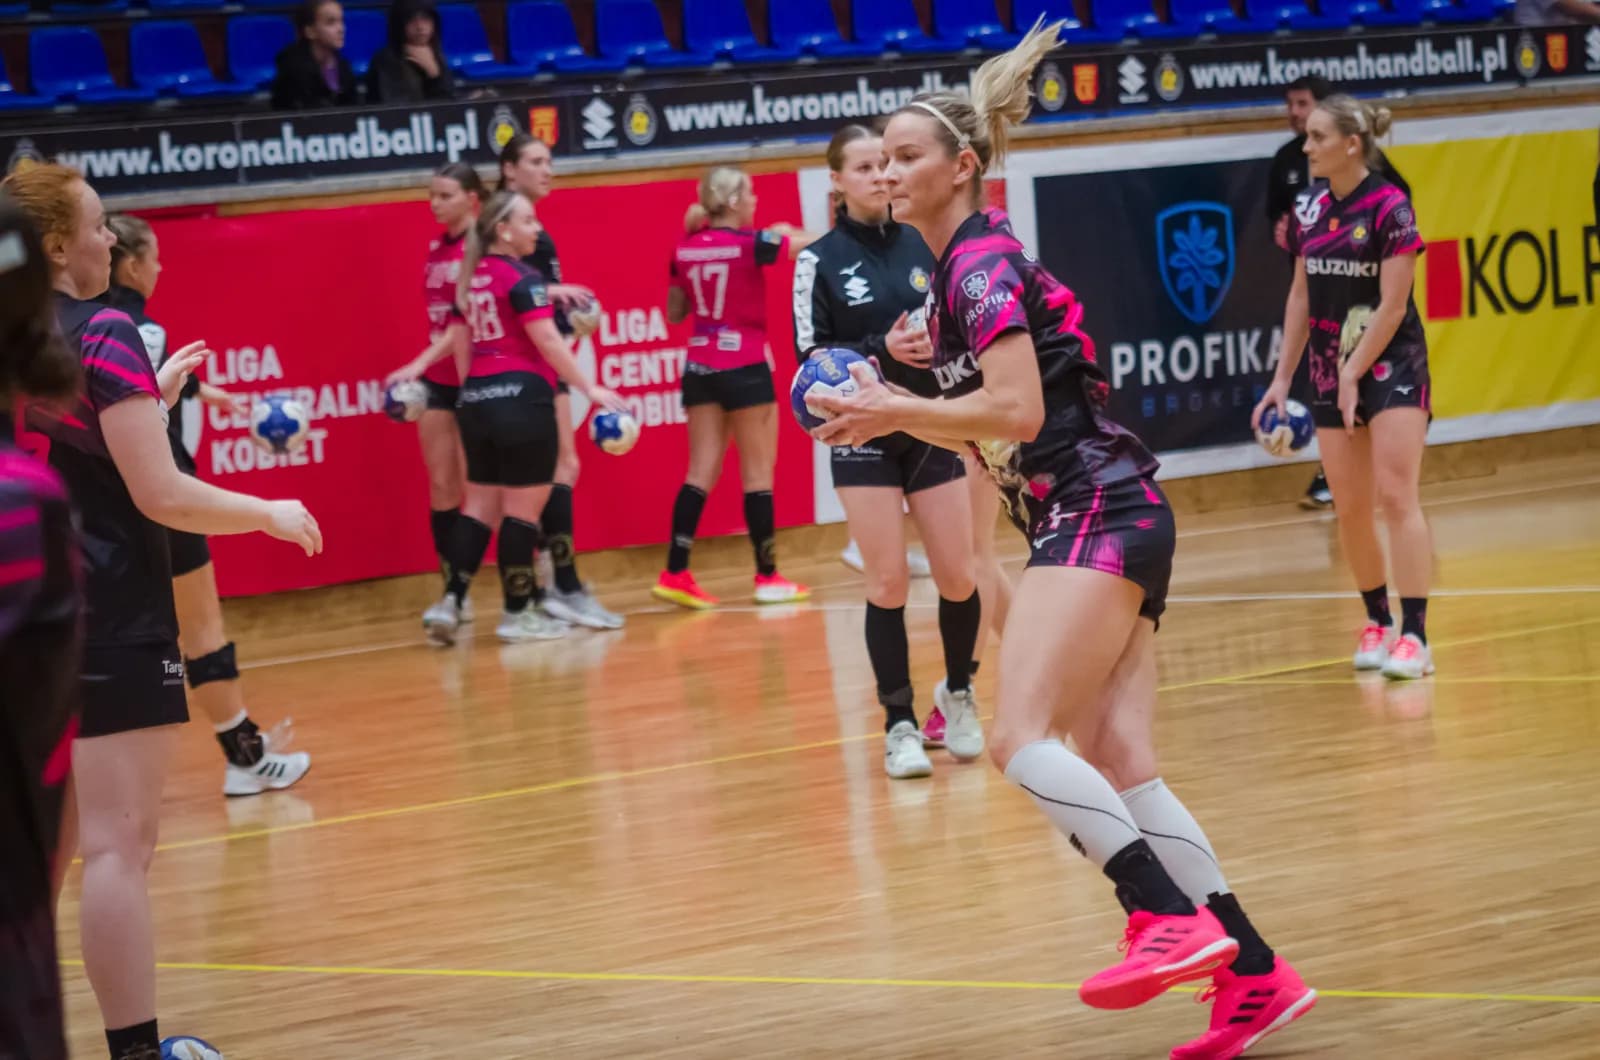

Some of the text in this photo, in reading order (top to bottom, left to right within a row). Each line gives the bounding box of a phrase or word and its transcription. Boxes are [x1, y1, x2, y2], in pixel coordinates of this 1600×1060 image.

[1189, 33, 1507, 89] www.koronahandball.pl
[54, 108, 479, 177] www.koronahandball.pl
[686, 263, 729, 320] 17
[1306, 256, 1379, 278] SUZUKI
[599, 306, 669, 346] LIGA
[206, 344, 283, 386] LIGA
[1110, 325, 1284, 390] PROFIKA
